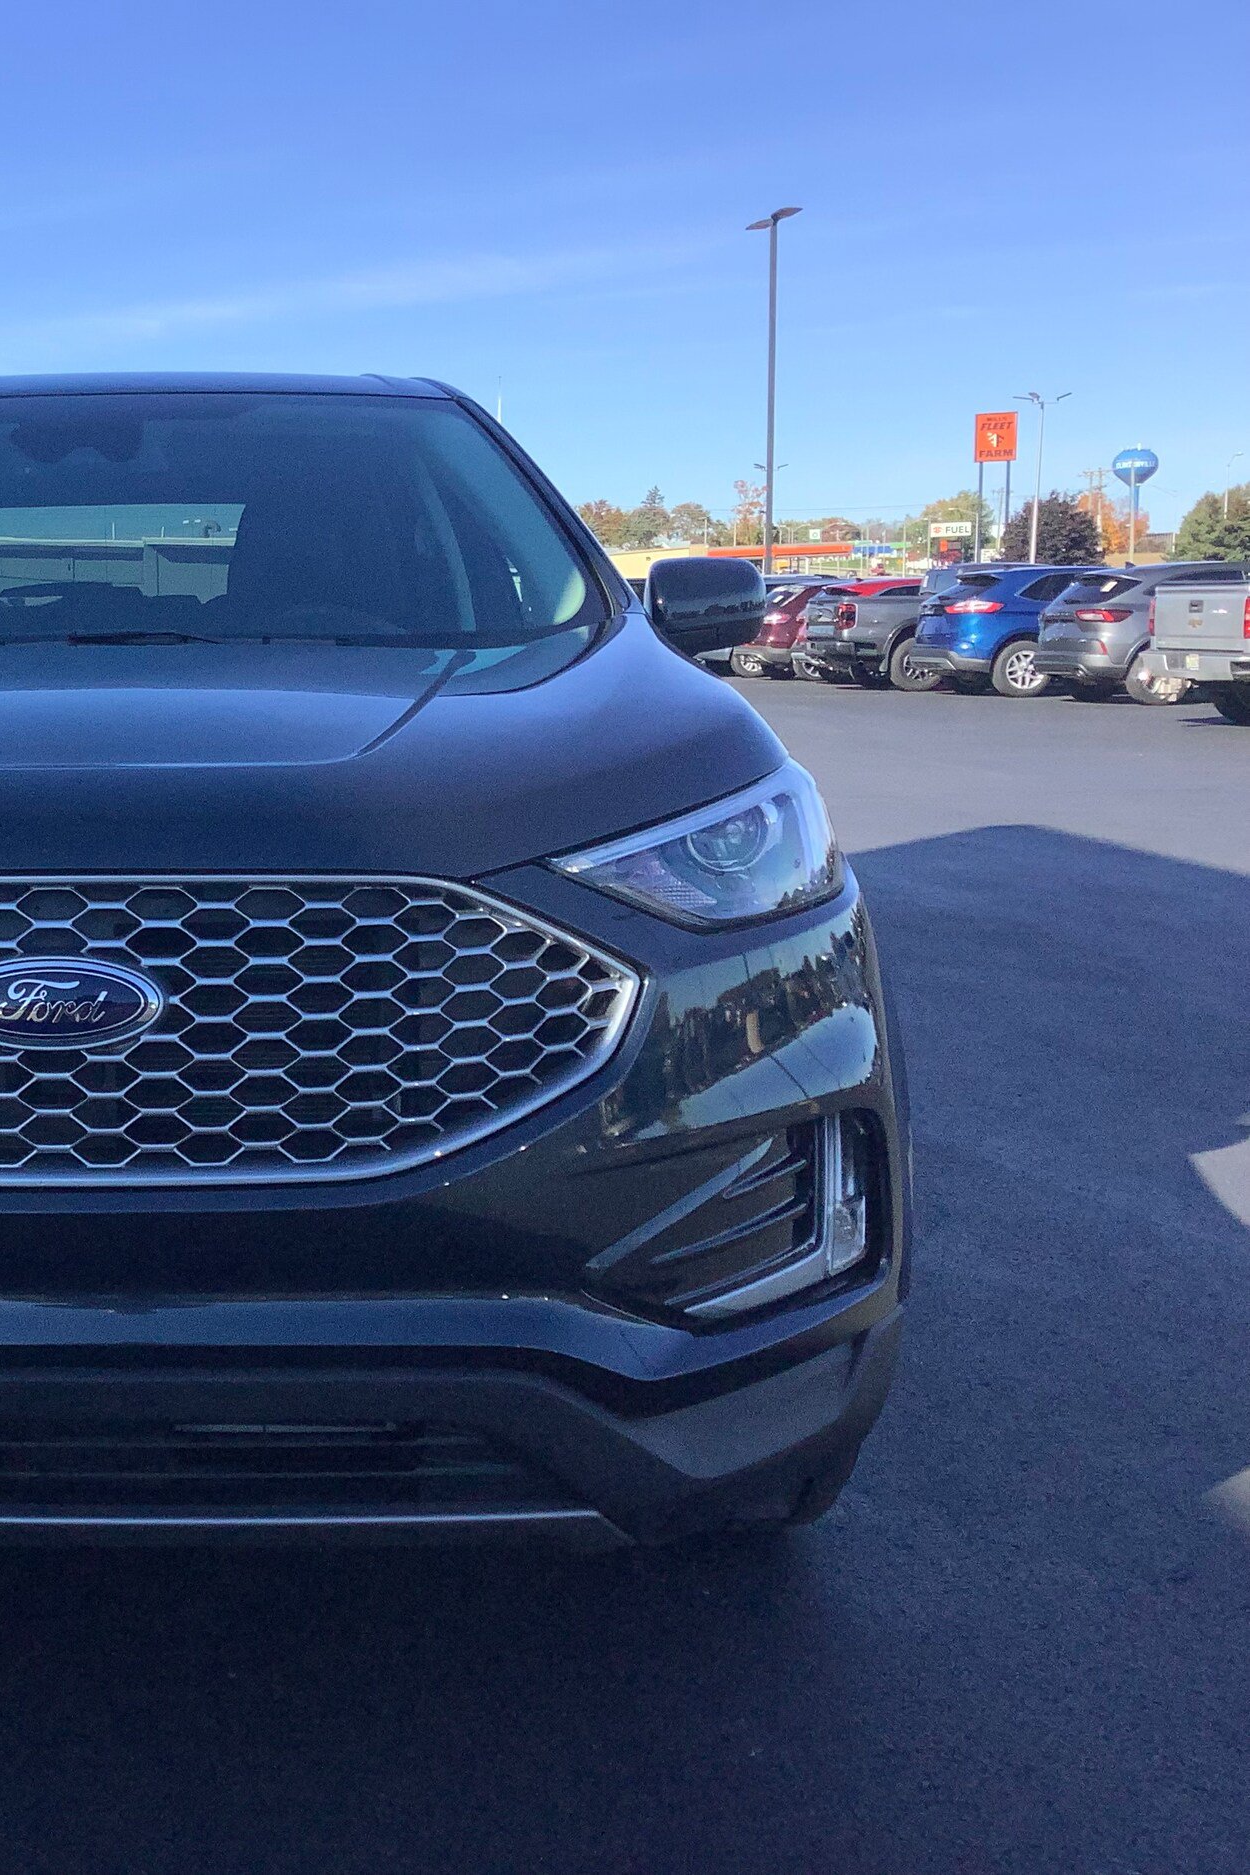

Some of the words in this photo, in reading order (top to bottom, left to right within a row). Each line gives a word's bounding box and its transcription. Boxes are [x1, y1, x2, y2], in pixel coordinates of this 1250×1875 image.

[980, 421, 1014, 431] FLEET
[979, 449, 1014, 458] FARM
[945, 525, 969, 534] FUEL
